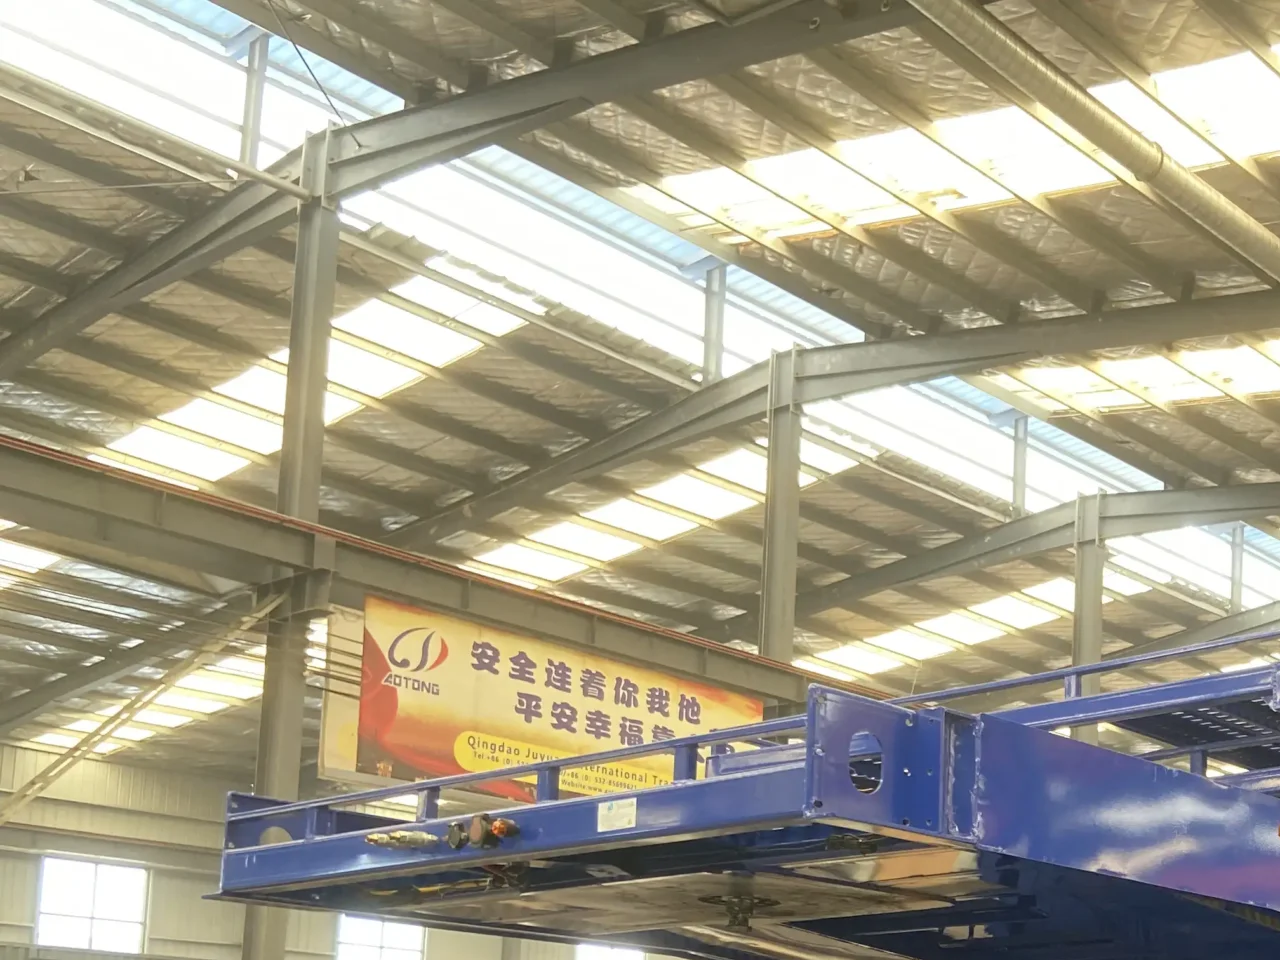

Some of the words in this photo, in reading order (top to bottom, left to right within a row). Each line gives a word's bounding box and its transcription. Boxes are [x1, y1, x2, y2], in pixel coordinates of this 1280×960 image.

[384, 673, 440, 696] AOTONG
[471, 641, 701, 725] 安全连着你我他
[514, 691, 735, 763] 平安幸福靠
[467, 735, 520, 756] Qingdao
[581, 764, 648, 784] ternational
[653, 775, 675, 785] Tra
